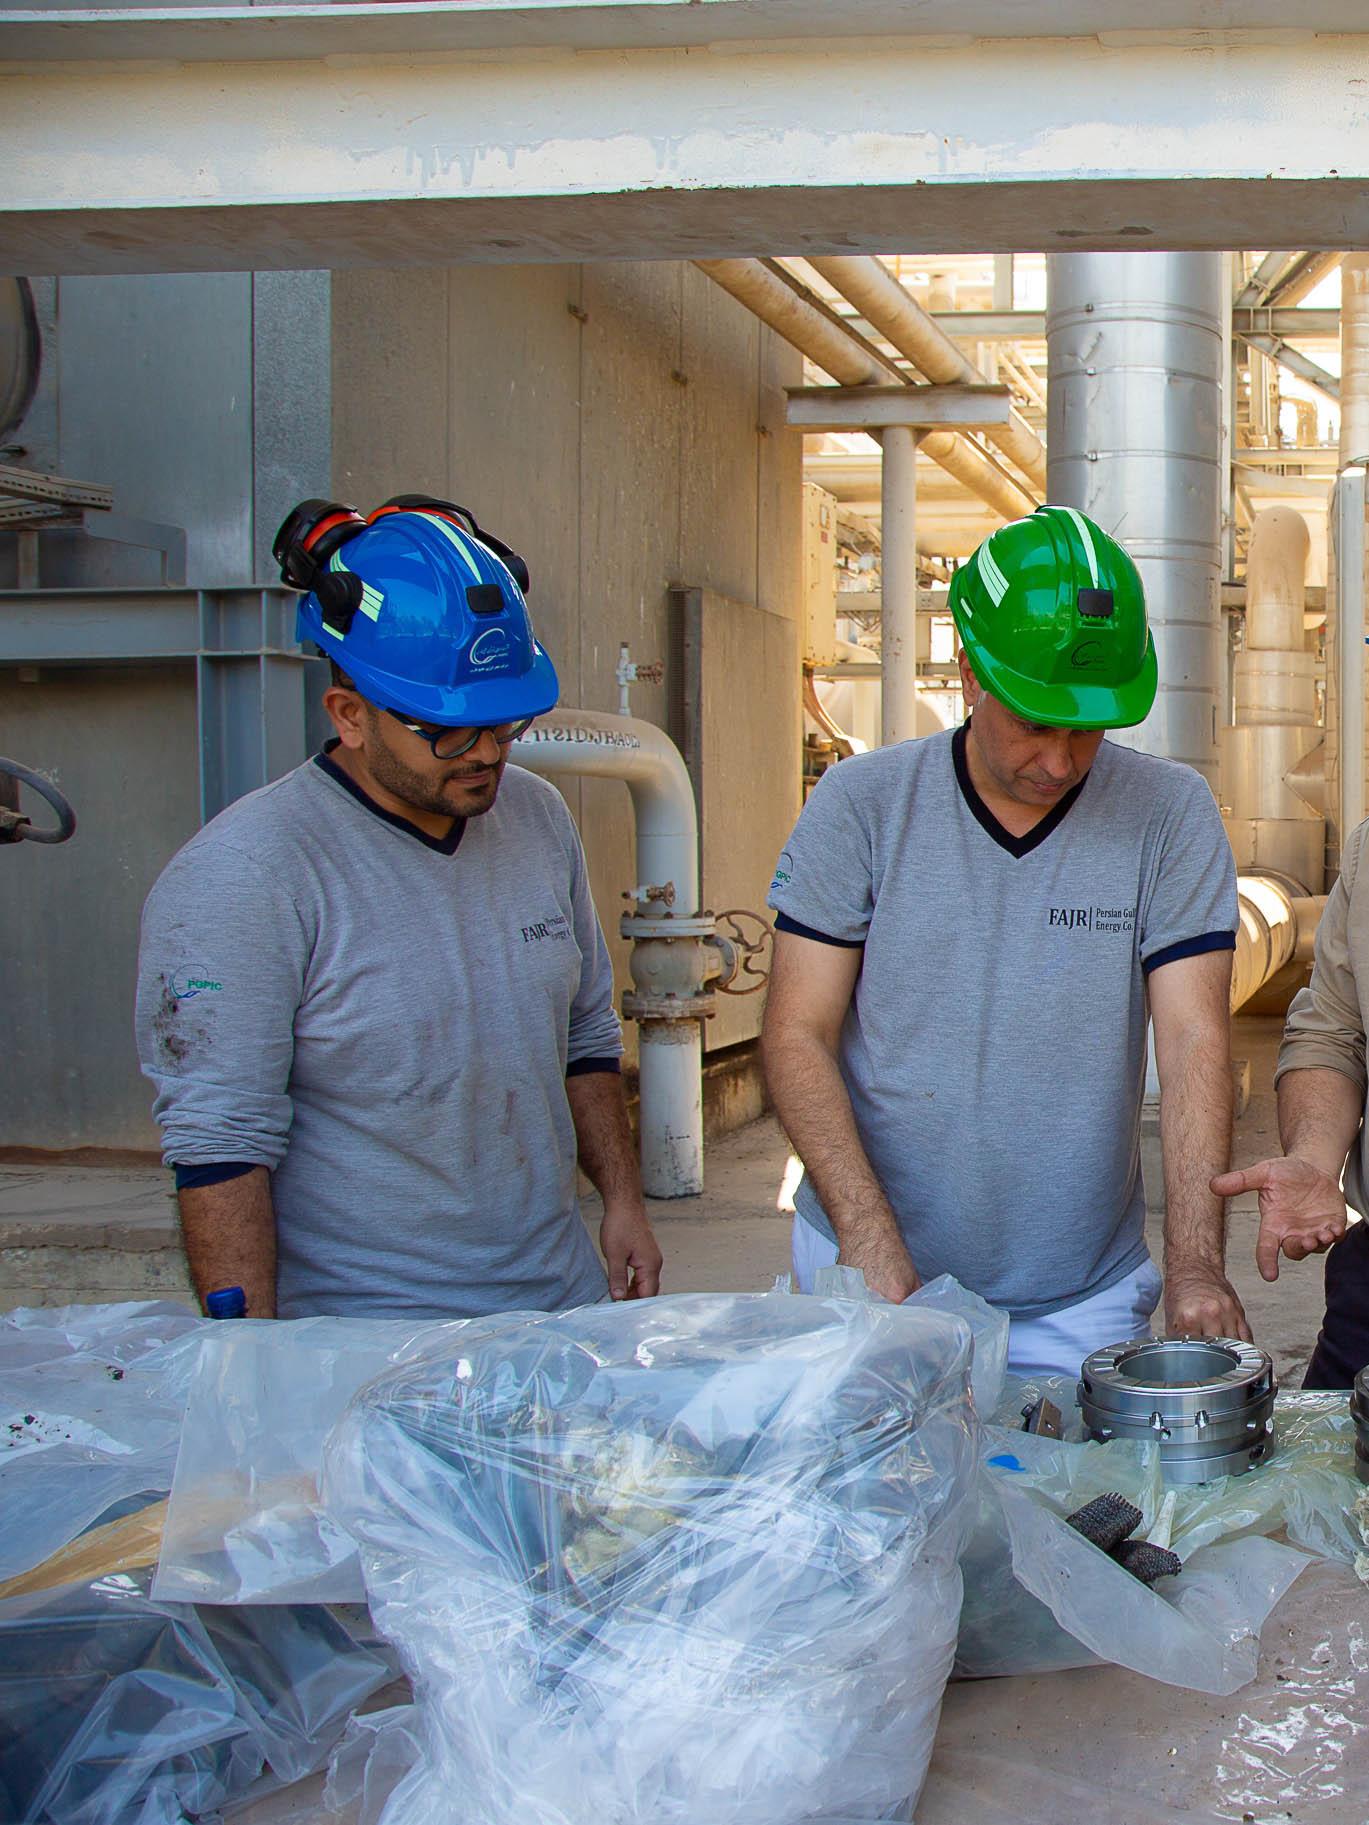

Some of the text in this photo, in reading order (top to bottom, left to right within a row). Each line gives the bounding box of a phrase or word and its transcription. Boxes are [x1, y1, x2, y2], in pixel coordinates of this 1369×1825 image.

[1048, 908, 1088, 930] FAJR
[1095, 907, 1137, 918] Persian Gul
[1095, 920, 1121, 934] Energy
